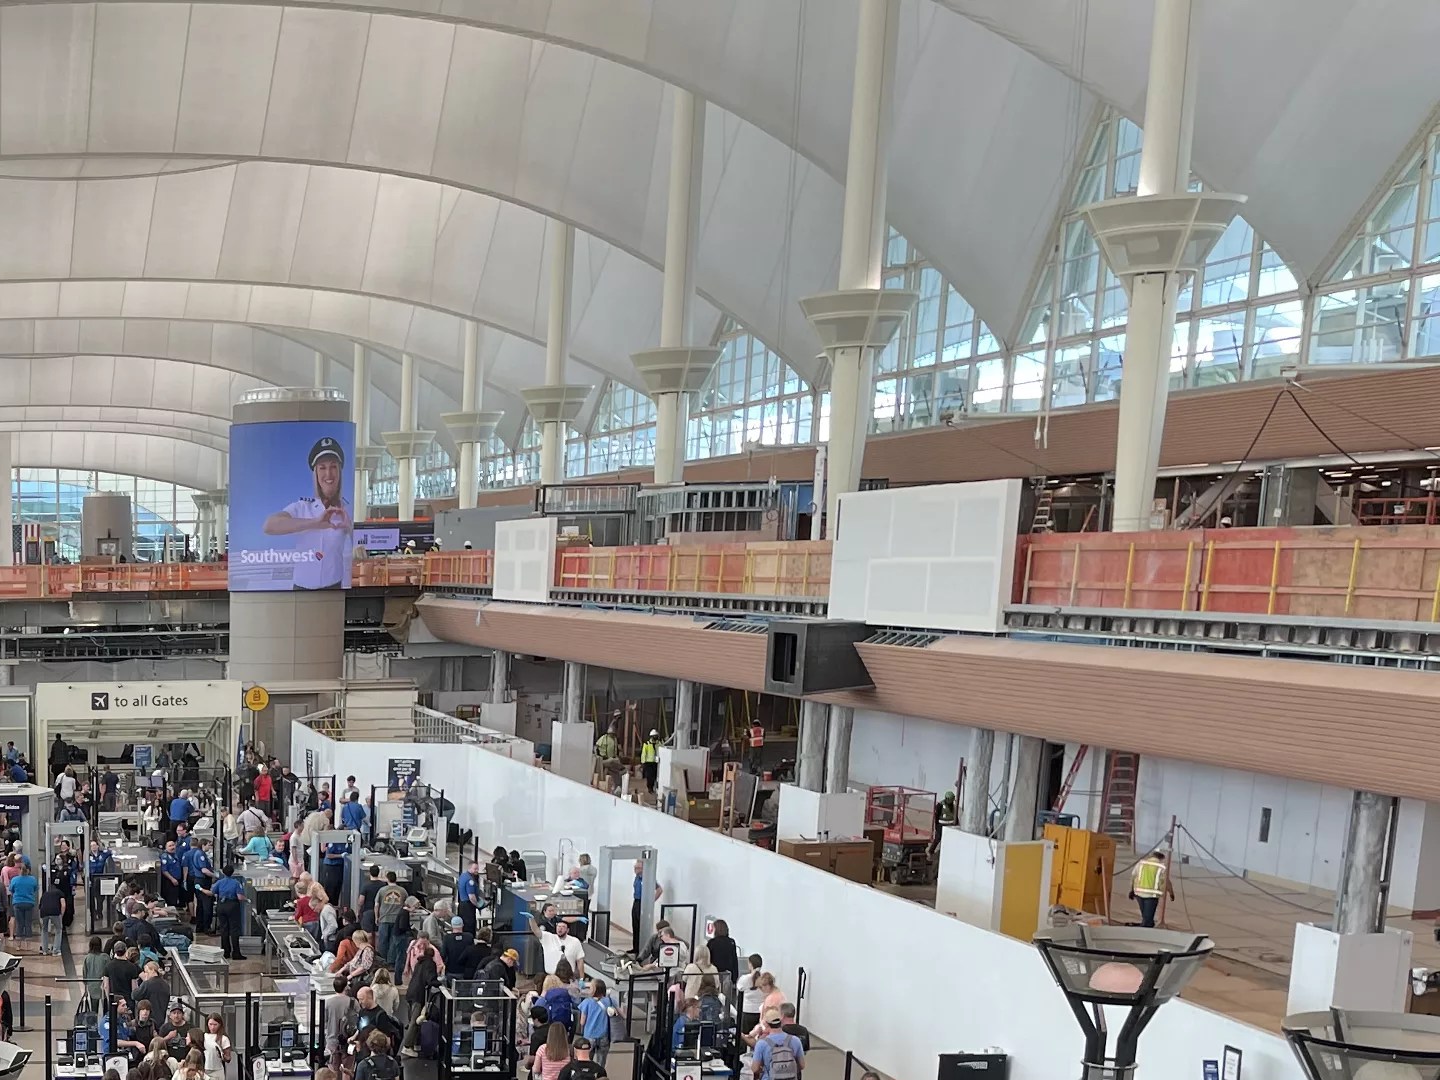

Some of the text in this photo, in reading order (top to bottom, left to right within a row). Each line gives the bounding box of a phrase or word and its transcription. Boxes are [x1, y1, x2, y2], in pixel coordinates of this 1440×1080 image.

[240, 548, 315, 564] Southwest
[114, 694, 189, 707] to all Gates
